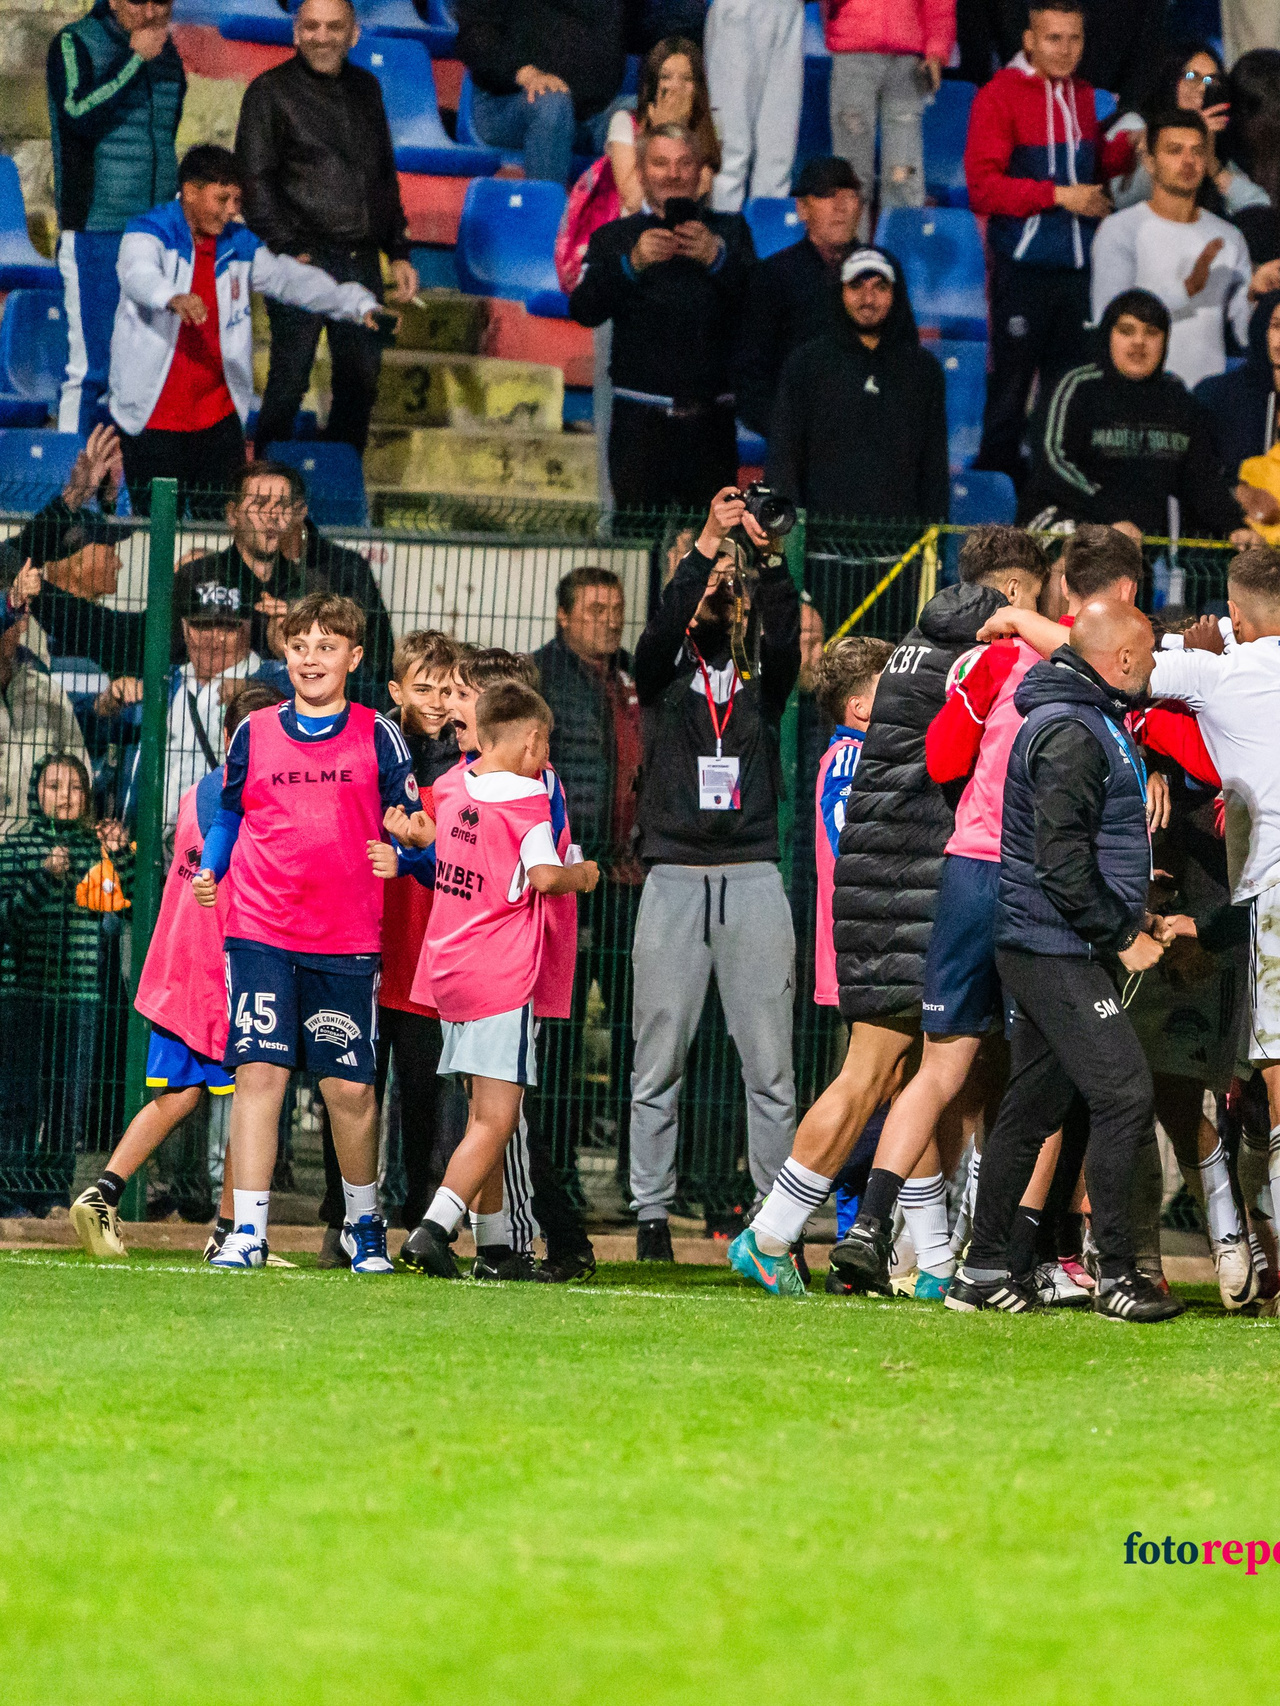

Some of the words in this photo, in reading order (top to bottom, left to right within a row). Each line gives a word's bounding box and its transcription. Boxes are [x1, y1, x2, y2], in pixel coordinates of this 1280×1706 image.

[271, 769, 353, 786] KELME
[450, 826, 478, 845] errea
[235, 992, 277, 1035] 45
[922, 999, 945, 1012] stra
[1093, 998, 1120, 1019] SM
[308, 1016, 322, 1029] FIVE
[322, 1015, 359, 1036] CONTINENTS
[258, 1040, 289, 1051] Vestra
